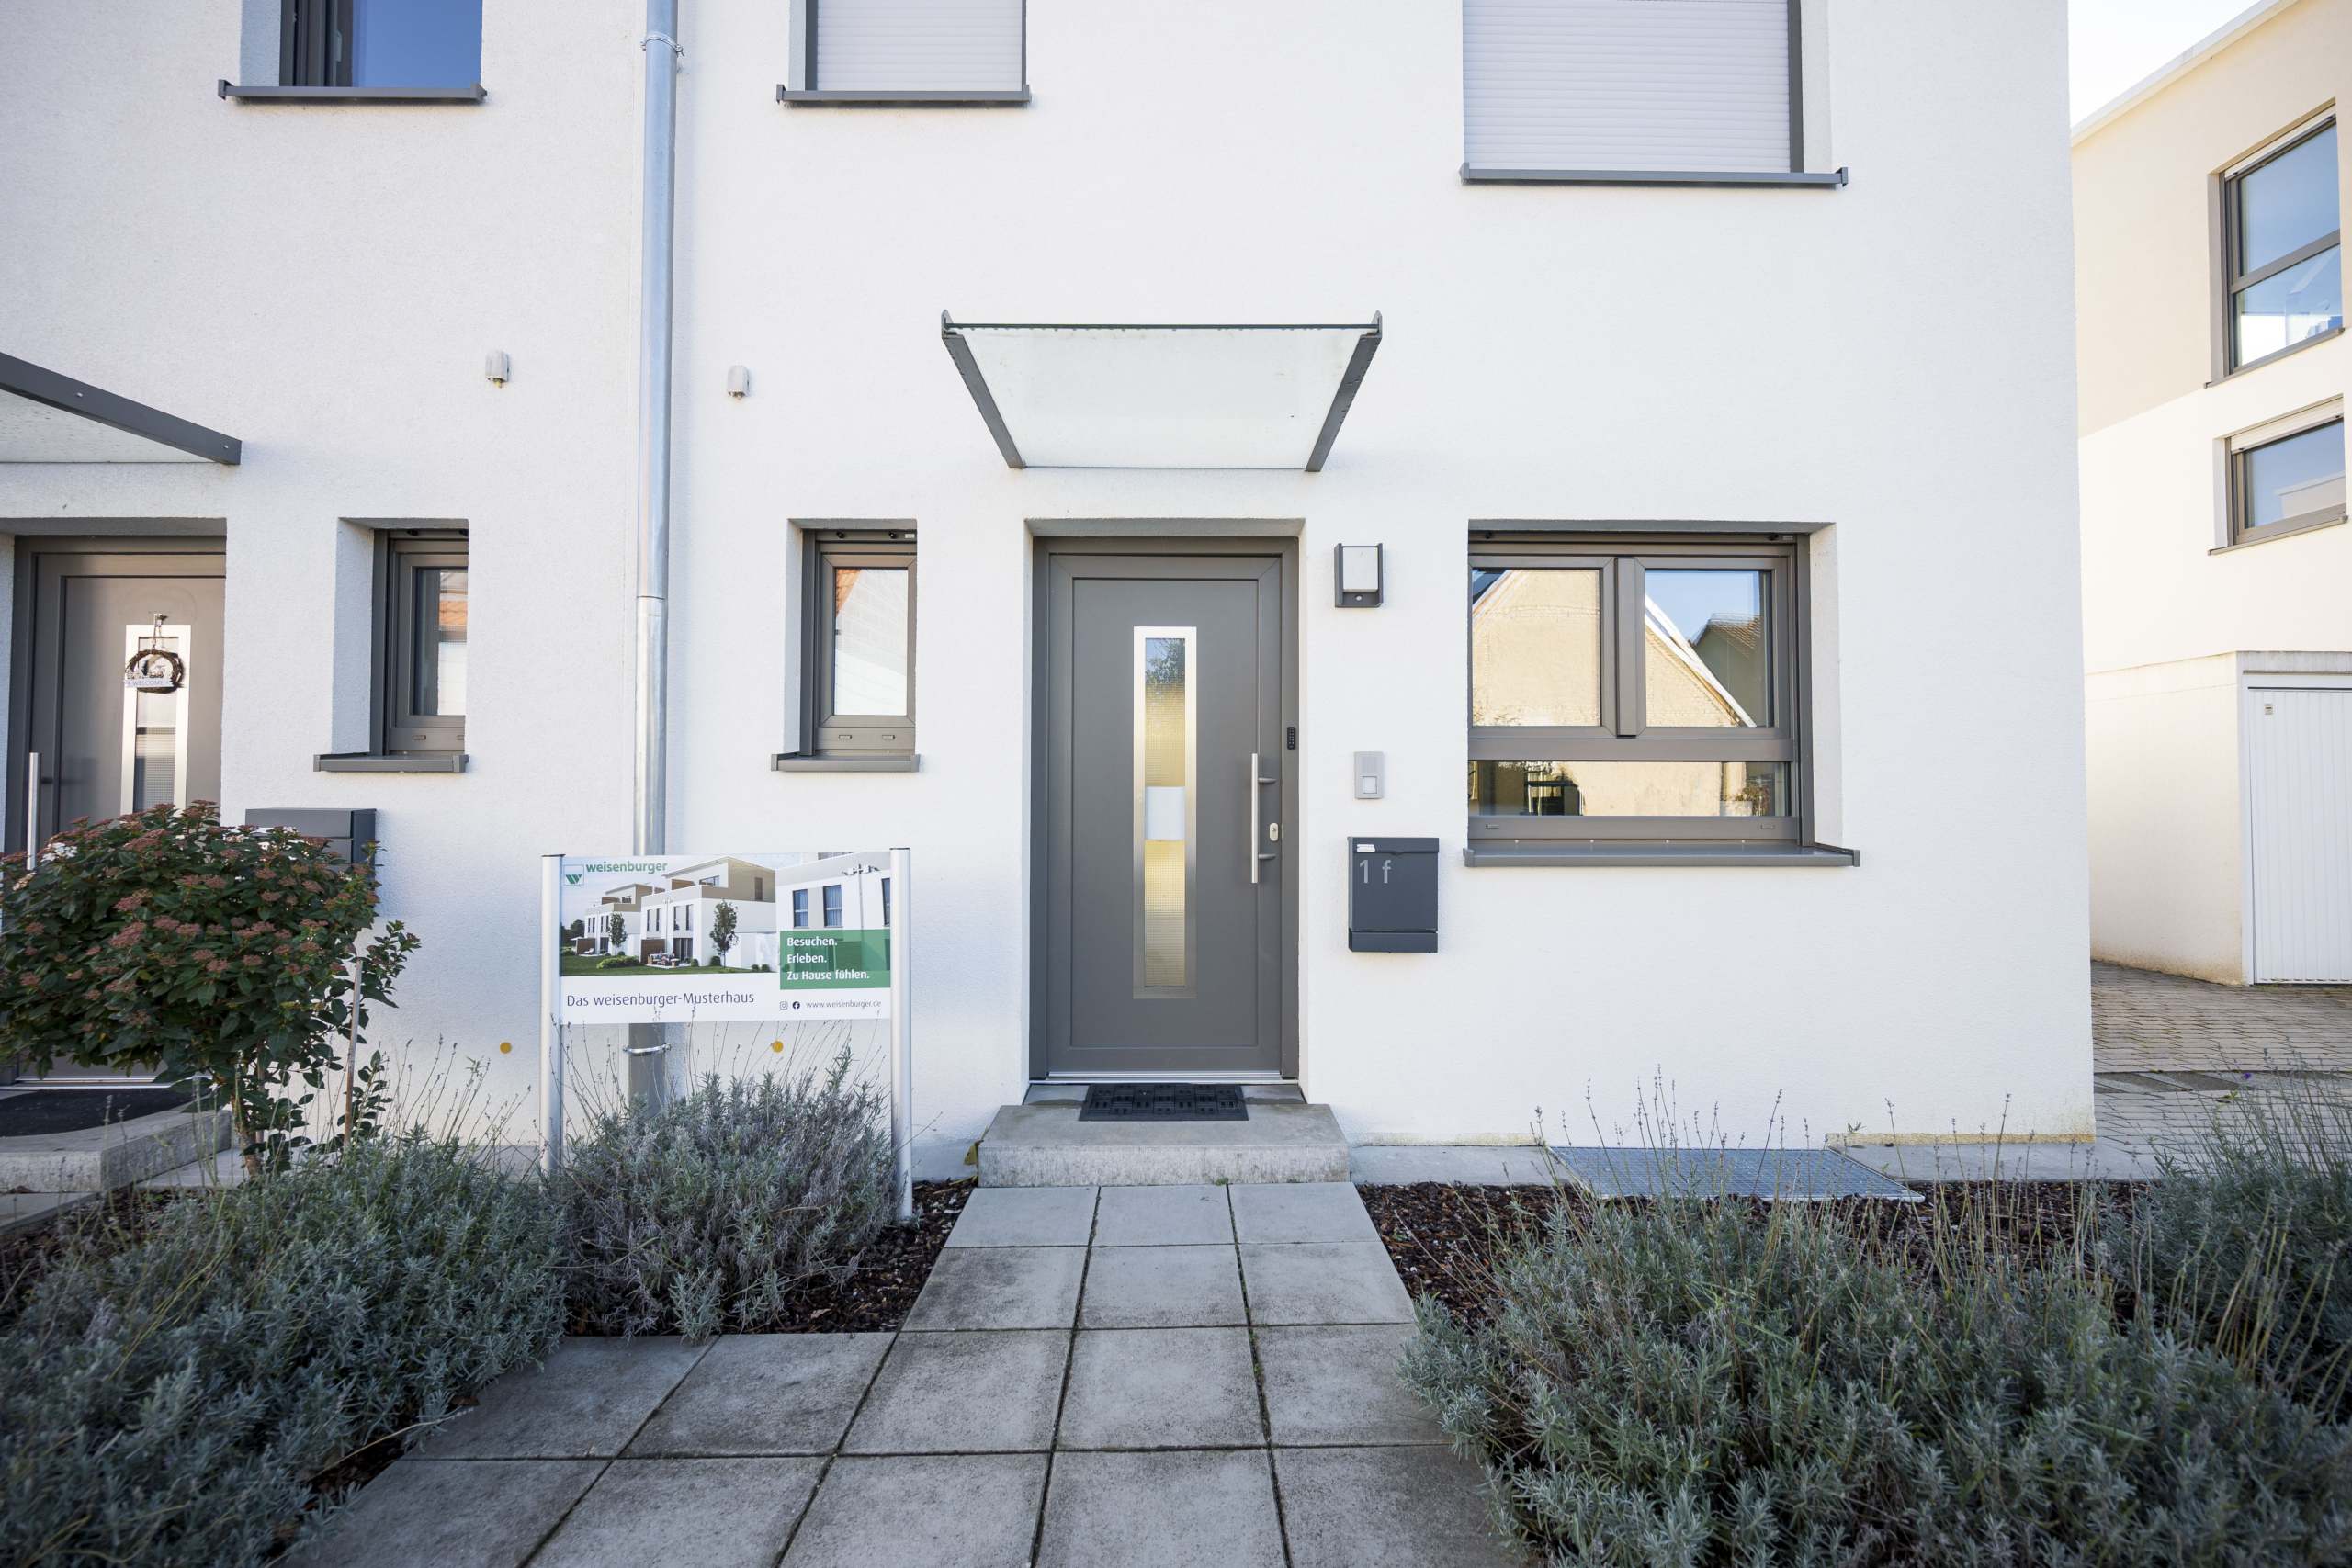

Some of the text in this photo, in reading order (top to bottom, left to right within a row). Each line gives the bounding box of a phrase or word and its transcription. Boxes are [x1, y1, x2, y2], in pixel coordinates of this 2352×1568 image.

[585, 861, 668, 874] weisenburger
[1359, 859, 1392, 884] 1 f
[786, 936, 838, 947] Besuchen.
[786, 953, 828, 964] Erleben.
[786, 969, 870, 980] Zu Hause fühlen.
[567, 990, 754, 1009] Das weisenburger-Musterhaus
[806, 999, 882, 1010] www.weisenburger.de
